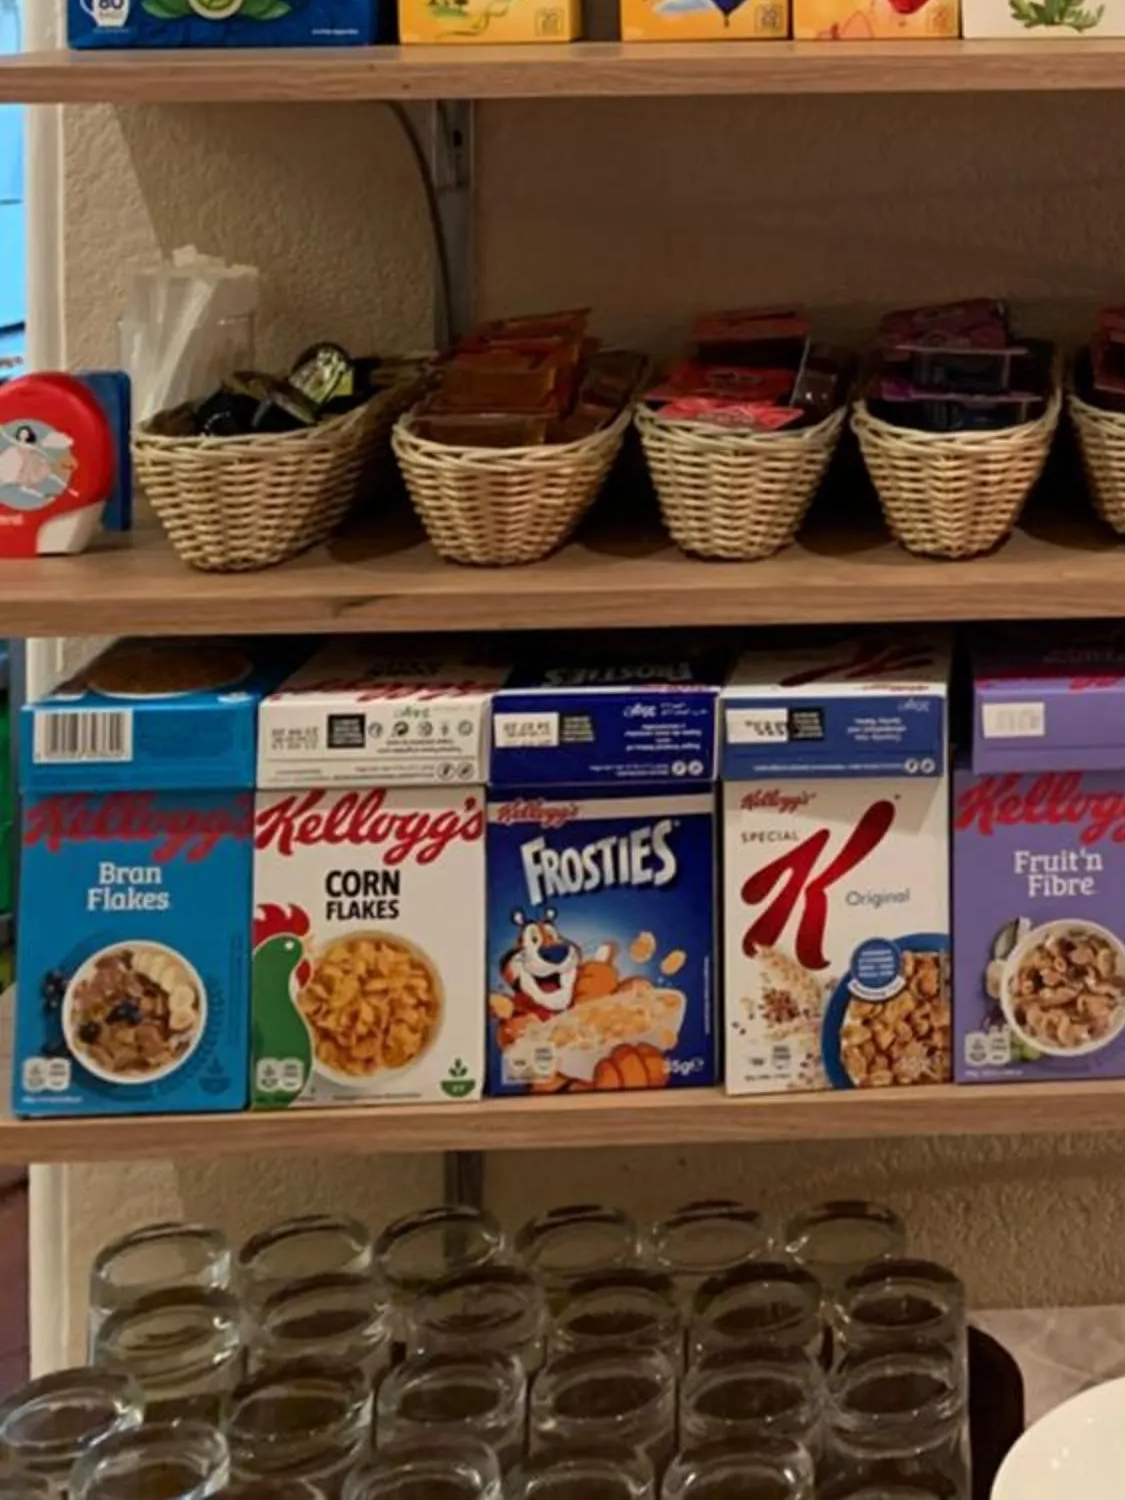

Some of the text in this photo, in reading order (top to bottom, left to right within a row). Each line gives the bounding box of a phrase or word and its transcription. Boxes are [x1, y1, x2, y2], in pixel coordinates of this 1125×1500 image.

[740, 790, 812, 813] Kellogg's
[22, 791, 253, 864] Kellogg's
[255, 788, 484, 865] Kellogg's
[496, 802, 580, 829] Kellogg's
[740, 830, 798, 844] SPECIAL
[99, 861, 162, 885] Bran
[519, 822, 678, 906] FROSTIES
[325, 869, 400, 898] CORN
[740, 799, 896, 971] K
[1028, 874, 1096, 898] Fibre
[87, 888, 170, 912] Flakes
[325, 899, 400, 921] FLAKES
[845, 887, 911, 909] Original
